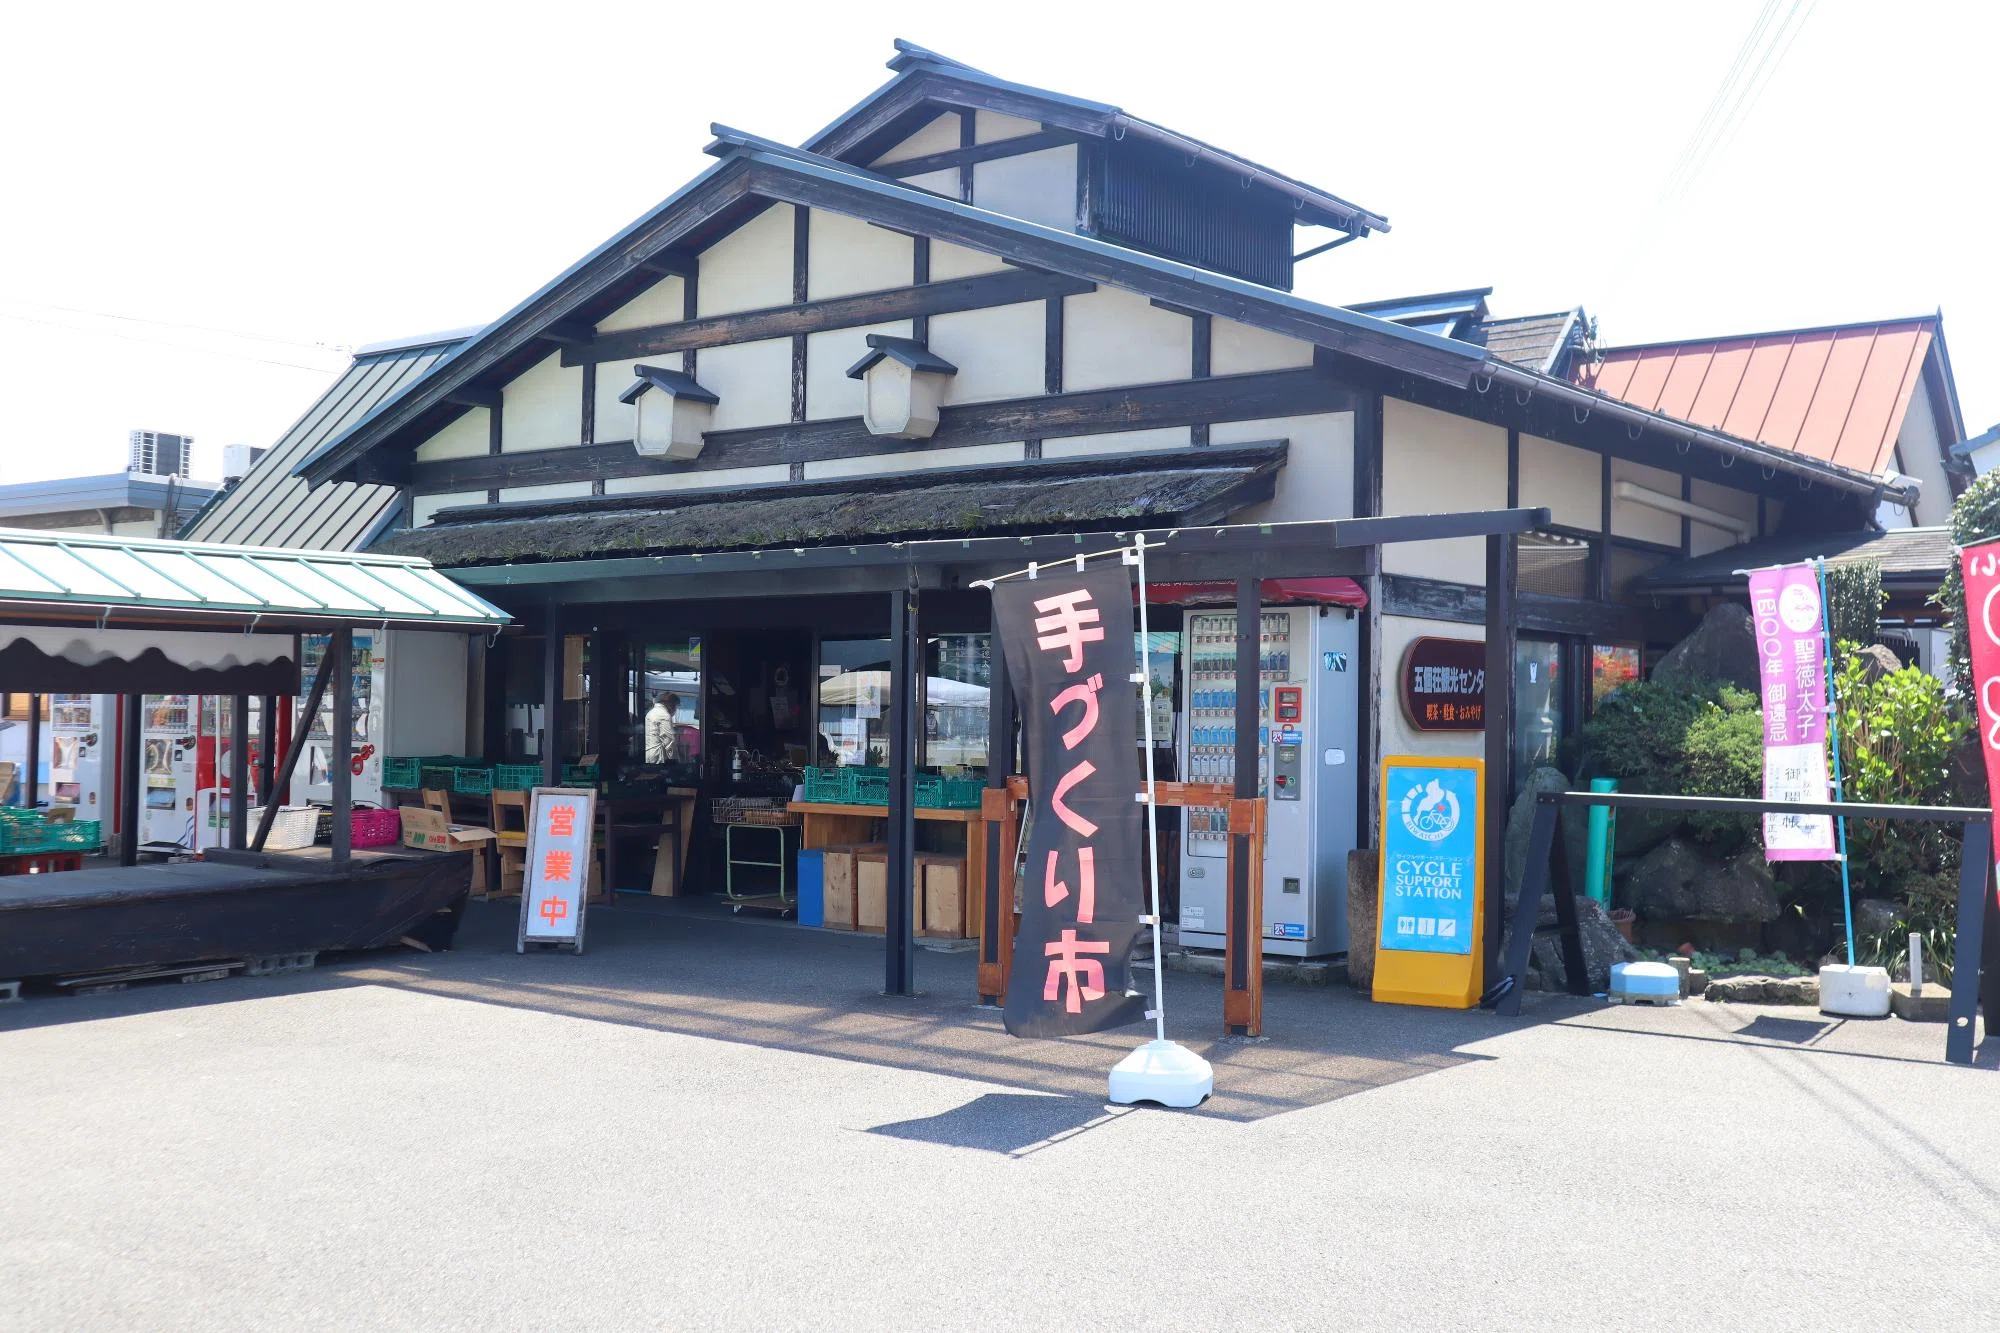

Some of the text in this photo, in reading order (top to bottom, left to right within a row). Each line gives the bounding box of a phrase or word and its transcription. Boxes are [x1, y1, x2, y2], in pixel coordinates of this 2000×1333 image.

[1414, 666, 1485, 694] 五個荘観光センタ
[1794, 638, 1817, 738] 聖徳太子
[1033, 588, 1110, 1014] 手づくり市
[540, 804, 576, 928] 営業中
[1396, 860, 1463, 877] CYCLE
[1395, 885, 1463, 900] STATION
[1396, 874, 1463, 888] SUPPORT
